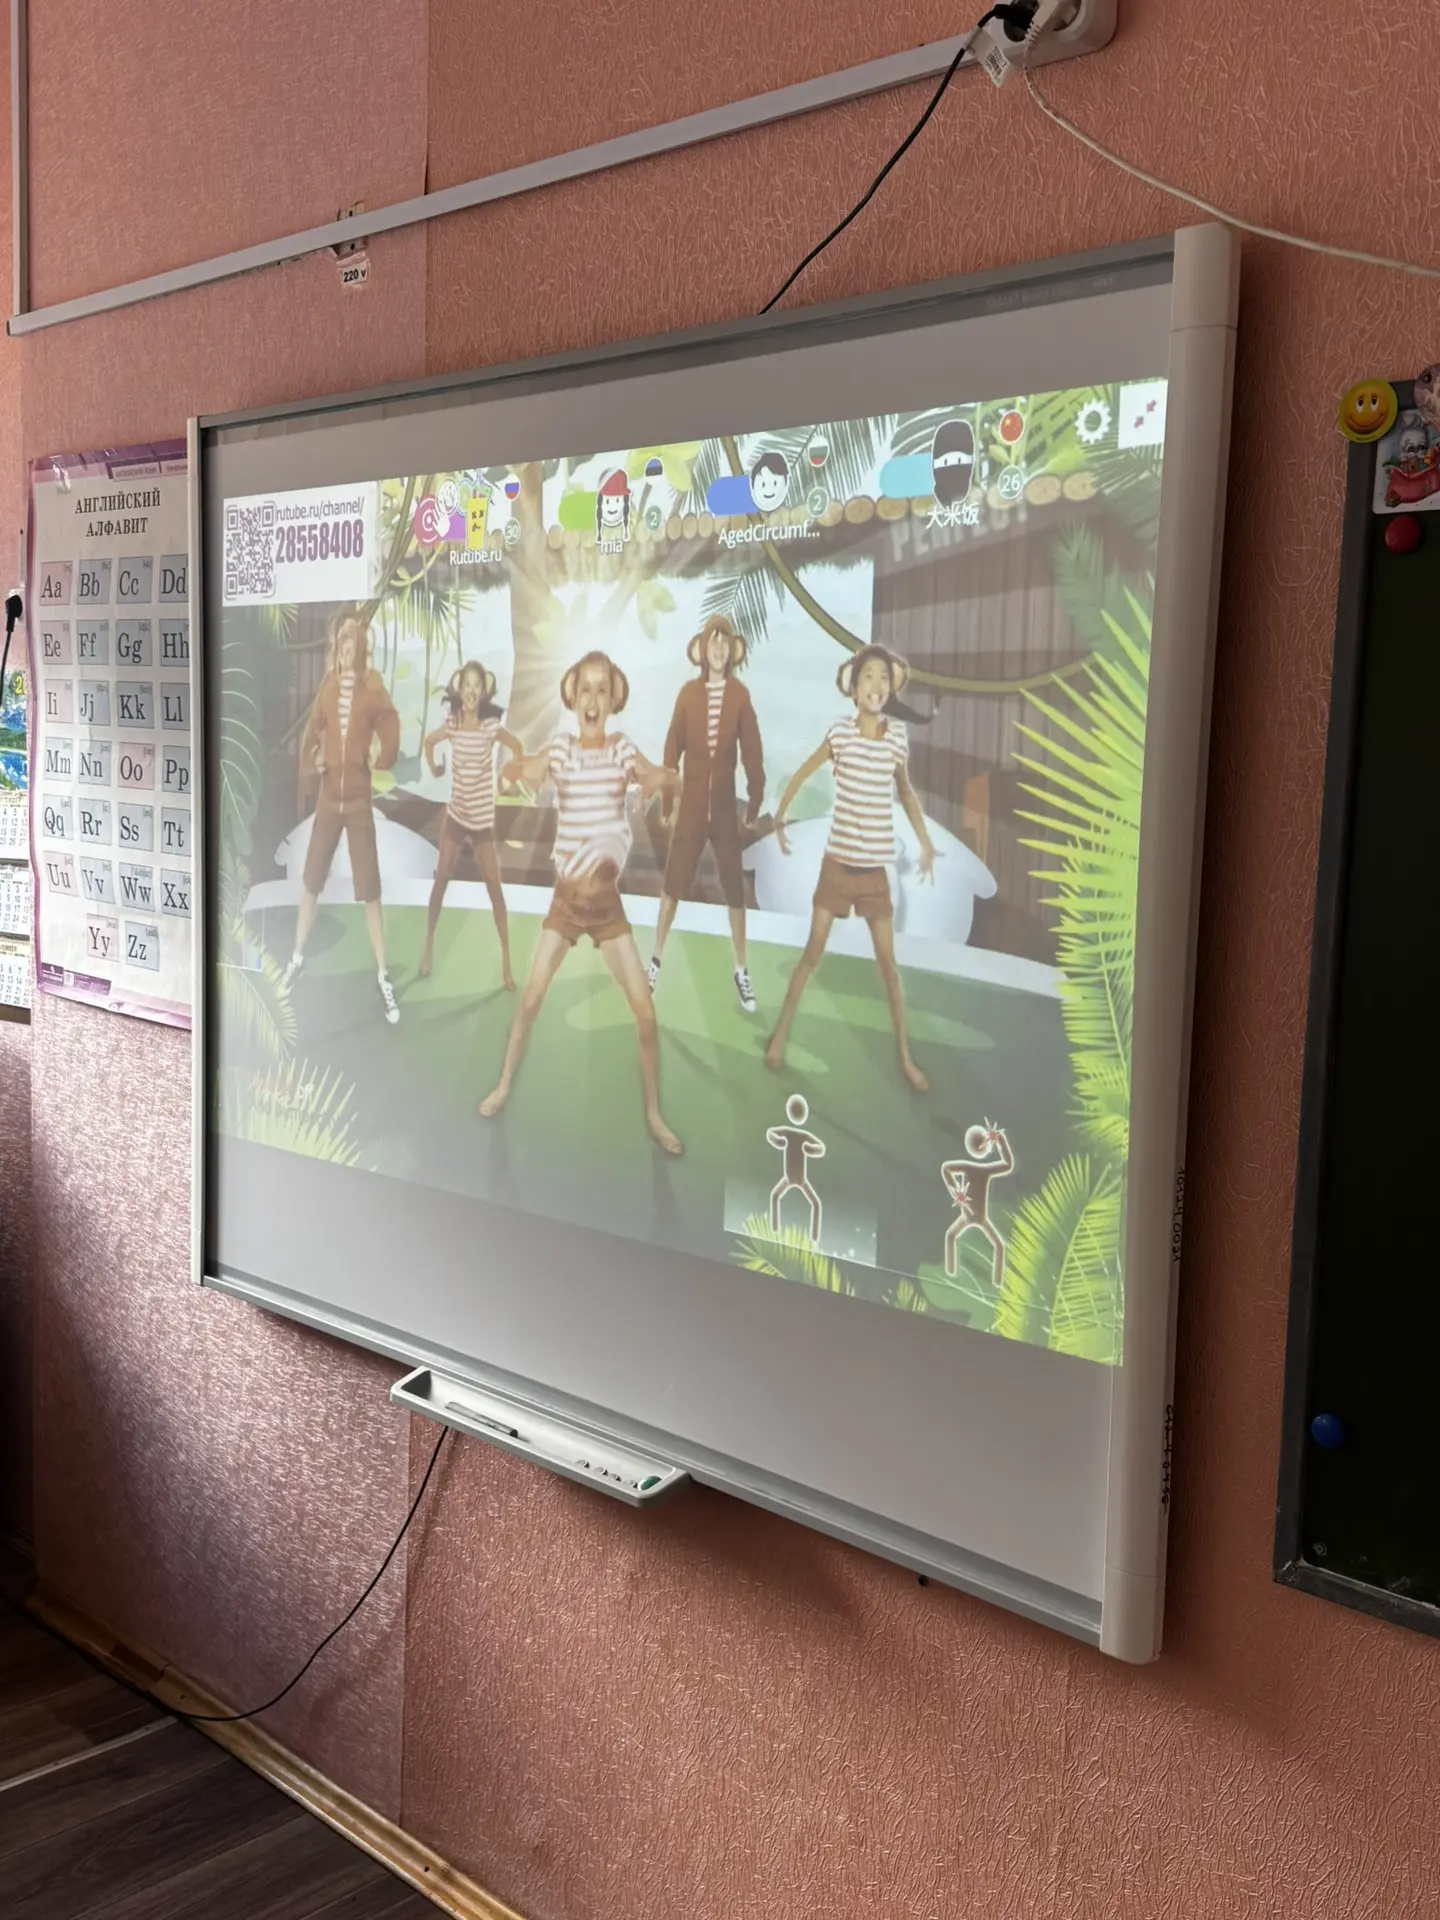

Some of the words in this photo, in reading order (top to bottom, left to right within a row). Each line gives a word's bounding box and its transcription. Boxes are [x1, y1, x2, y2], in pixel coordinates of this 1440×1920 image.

[343, 268, 359, 282] 220
[1001, 474, 1021, 492] 26
[75, 487, 161, 514] АНГЛИЙСКИЙ
[276, 496, 365, 521] rutube.ru/channel/
[86, 517, 149, 537] АЛФАВИТ
[275, 519, 364, 563] 28558408
[449, 549, 502, 565] Rutube.ru
[41, 575, 62, 599] Aa
[80, 573, 100, 597] Bb
[119, 570, 140, 596] Cc
[161, 568, 187, 594] Dd
[43, 633, 61, 657] Ee
[79, 633, 97, 657] Ff
[117, 632, 143, 664] Gg
[162, 632, 189, 659] Hh
[47, 692, 57, 715] Ii
[80, 692, 95, 723] Jj
[119, 694, 146, 721] Kk
[164, 696, 183, 722] Ll
[46, 749, 72, 775] Mm
[80, 752, 103, 778] Nn
[120, 755, 143, 782] Oo
[164, 758, 189, 791] Pp
[45, 806, 65, 837] Qq
[80, 811, 103, 837] Rr
[120, 815, 140, 842] Ss
[163, 821, 185, 848] Tt
[47, 863, 71, 889] Uu
[83, 869, 105, 895] Vv
[121, 875, 152, 903] Ww
[163, 882, 189, 910] Xx
[89, 926, 111, 957] Yy
[128, 934, 147, 960] Zz
